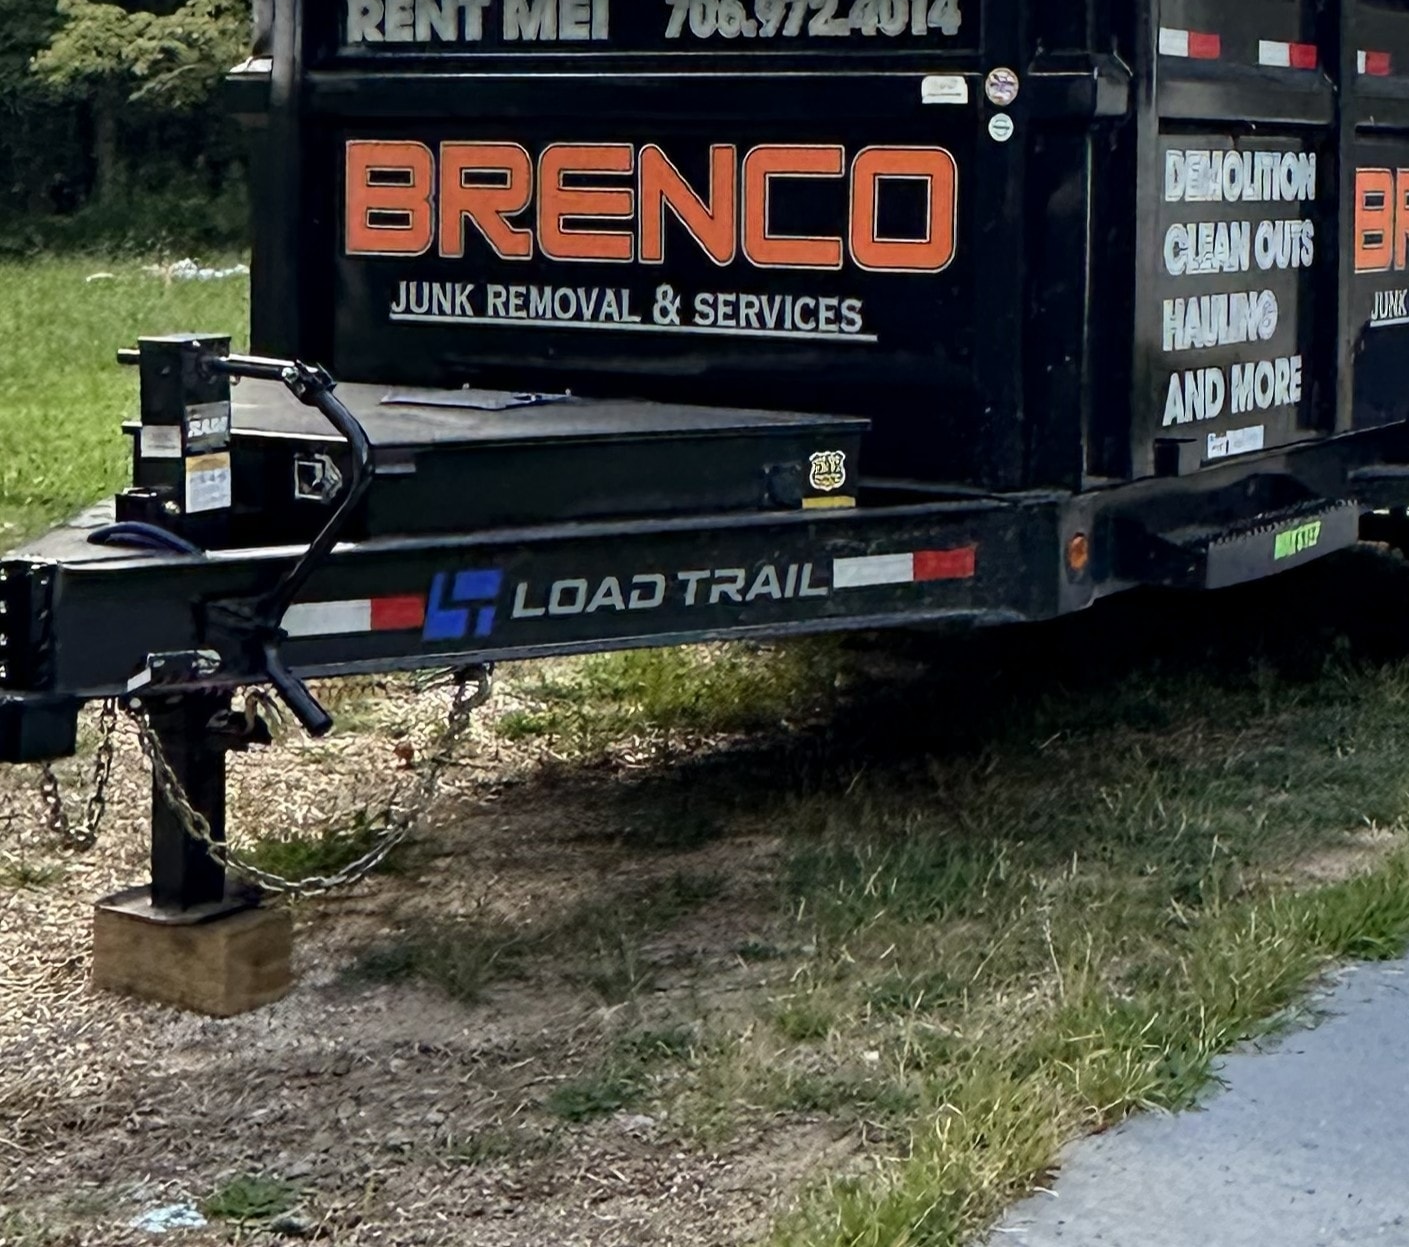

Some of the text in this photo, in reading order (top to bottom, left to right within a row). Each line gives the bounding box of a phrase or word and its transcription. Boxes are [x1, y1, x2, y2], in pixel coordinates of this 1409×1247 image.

[1164, 149, 1317, 202] DEMOLITION
[345, 139, 958, 273] BRENCO
[1163, 218, 1315, 276] CLEAN OUTS
[390, 279, 864, 334] JUNK REMOVAL & SERVICES
[1162, 289, 1279, 352] HAULING
[1370, 288, 1408, 321] JUNK
[1161, 354, 1303, 427] AND MORE
[510, 563, 829, 619] LOAD TRAIL
